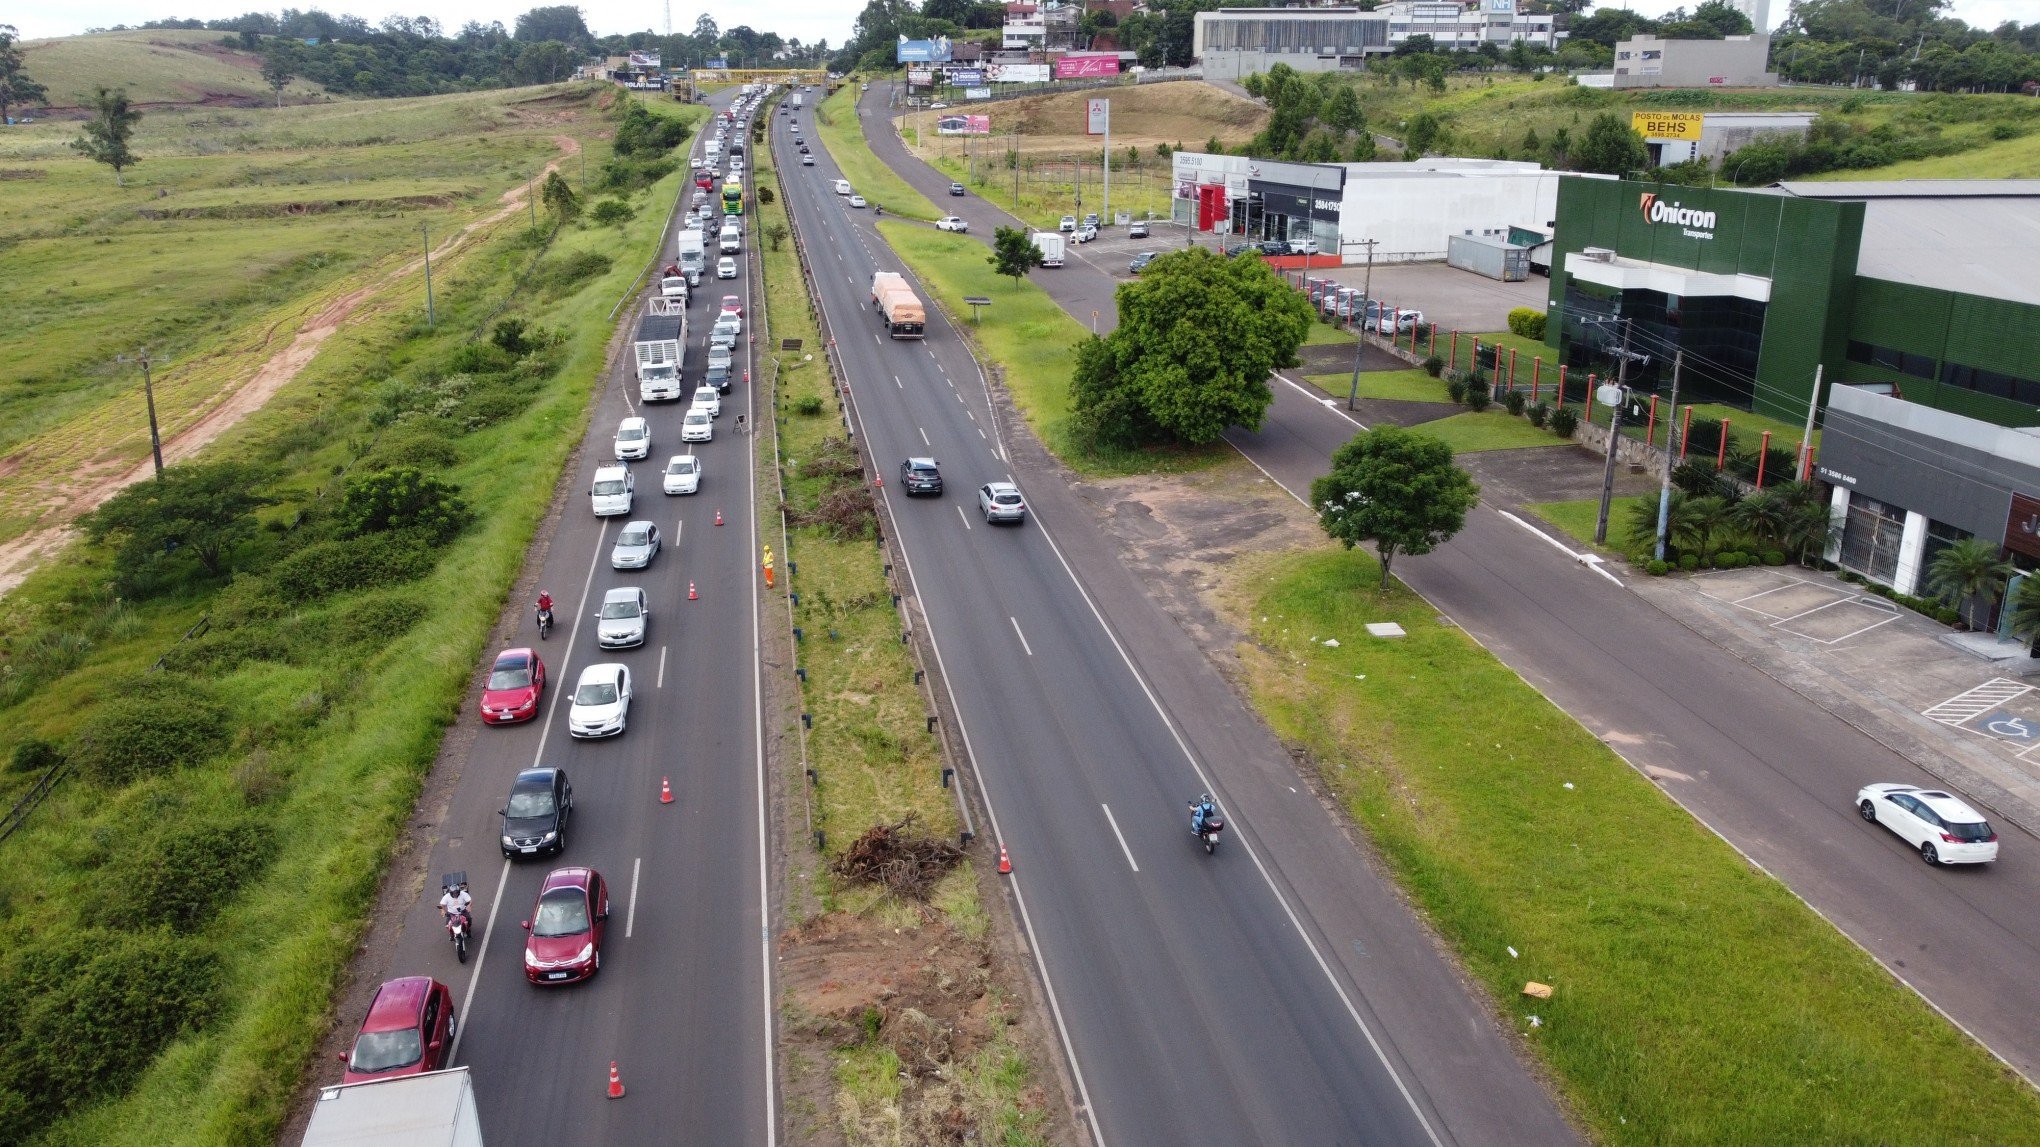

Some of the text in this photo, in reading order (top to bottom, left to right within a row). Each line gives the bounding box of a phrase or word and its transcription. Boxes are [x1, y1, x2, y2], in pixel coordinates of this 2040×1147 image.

[1492, 0, 1511, 9] NH
[1635, 112, 1662, 120] POSTO
[1671, 113, 1701, 122] MOLAS
[1647, 121, 1686, 133] BEHS
[1651, 200, 1717, 229] Onicron
[1683, 227, 1714, 240] Transportes
